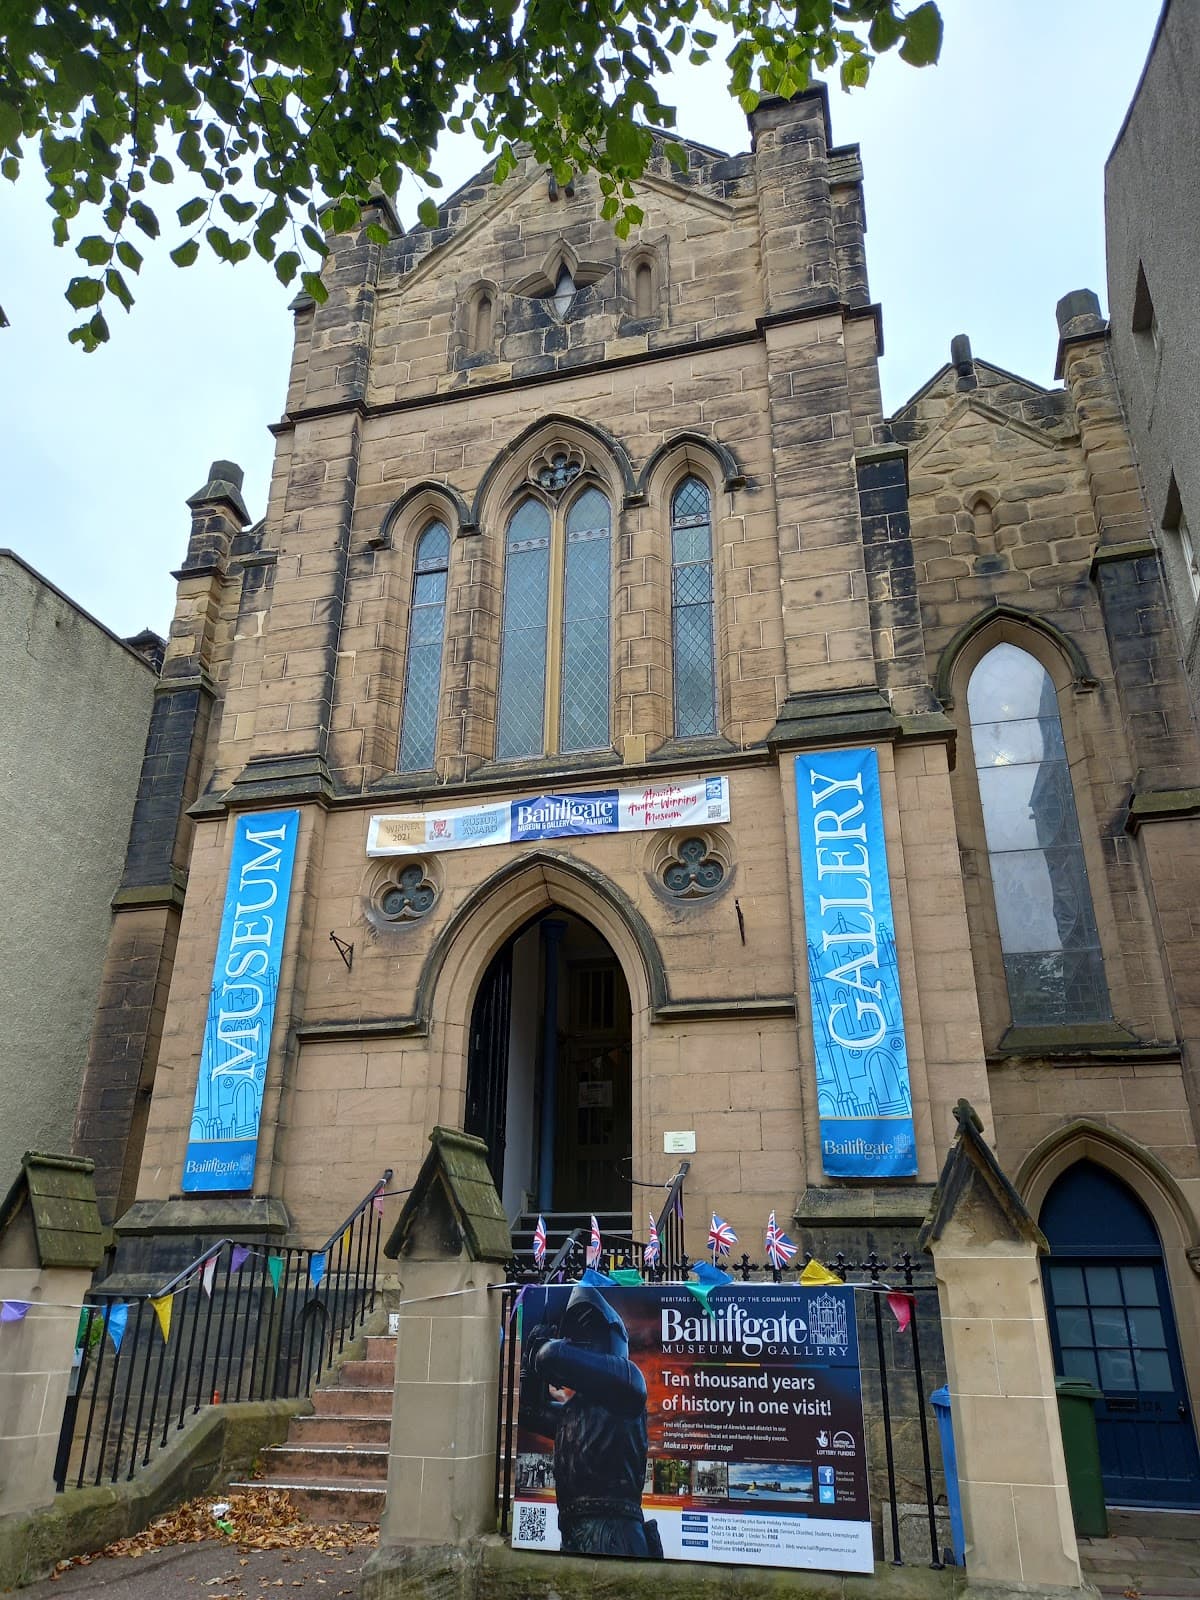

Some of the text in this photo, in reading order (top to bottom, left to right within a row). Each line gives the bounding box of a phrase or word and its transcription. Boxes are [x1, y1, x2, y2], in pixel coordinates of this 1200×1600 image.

[518, 799, 613, 826] Bailiffgate
[645, 811, 682, 825] Museum
[393, 833, 410, 842] 2021
[810, 769, 886, 1051] GALLERY
[212, 823, 287, 1082] MUSEUM
[824, 1137, 893, 1160] Bailiffgate
[186, 1157, 239, 1177] Bailiffgate
[661, 1303, 808, 1357] Bailiffgate
[662, 1345, 848, 1356] MUSEUM GALLERY
[662, 1371, 815, 1394] Ten thousand years
[662, 1395, 832, 1417] of history in one visit!
[663, 1441, 680, 1449] Make
